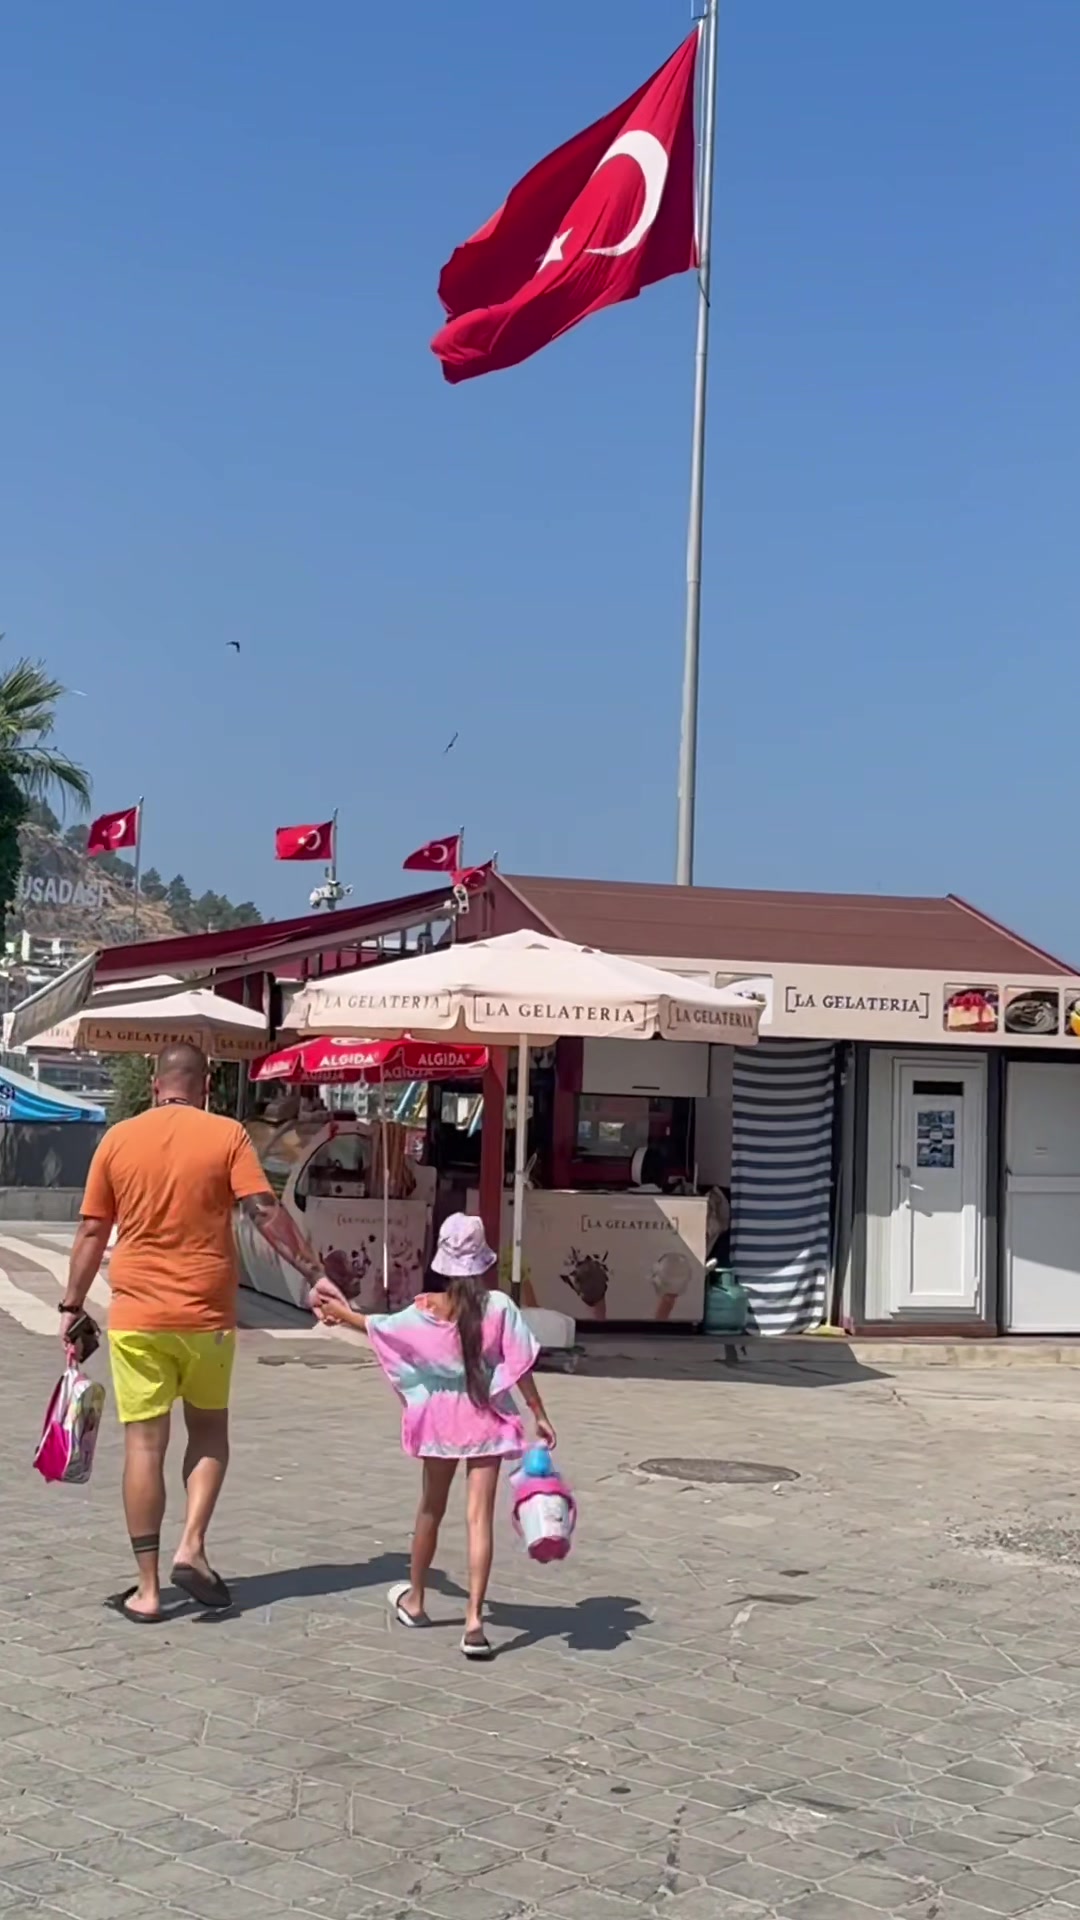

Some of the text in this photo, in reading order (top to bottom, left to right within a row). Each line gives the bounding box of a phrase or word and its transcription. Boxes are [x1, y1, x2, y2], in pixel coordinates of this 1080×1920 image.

[348, 995, 440, 1009] GELATERIA
[822, 995, 920, 1012] GELATERIA
[518, 1003, 635, 1023] GELATERIA
[319, 1052, 375, 1067] ALGIDA
[417, 1053, 466, 1065] ALGIDA
